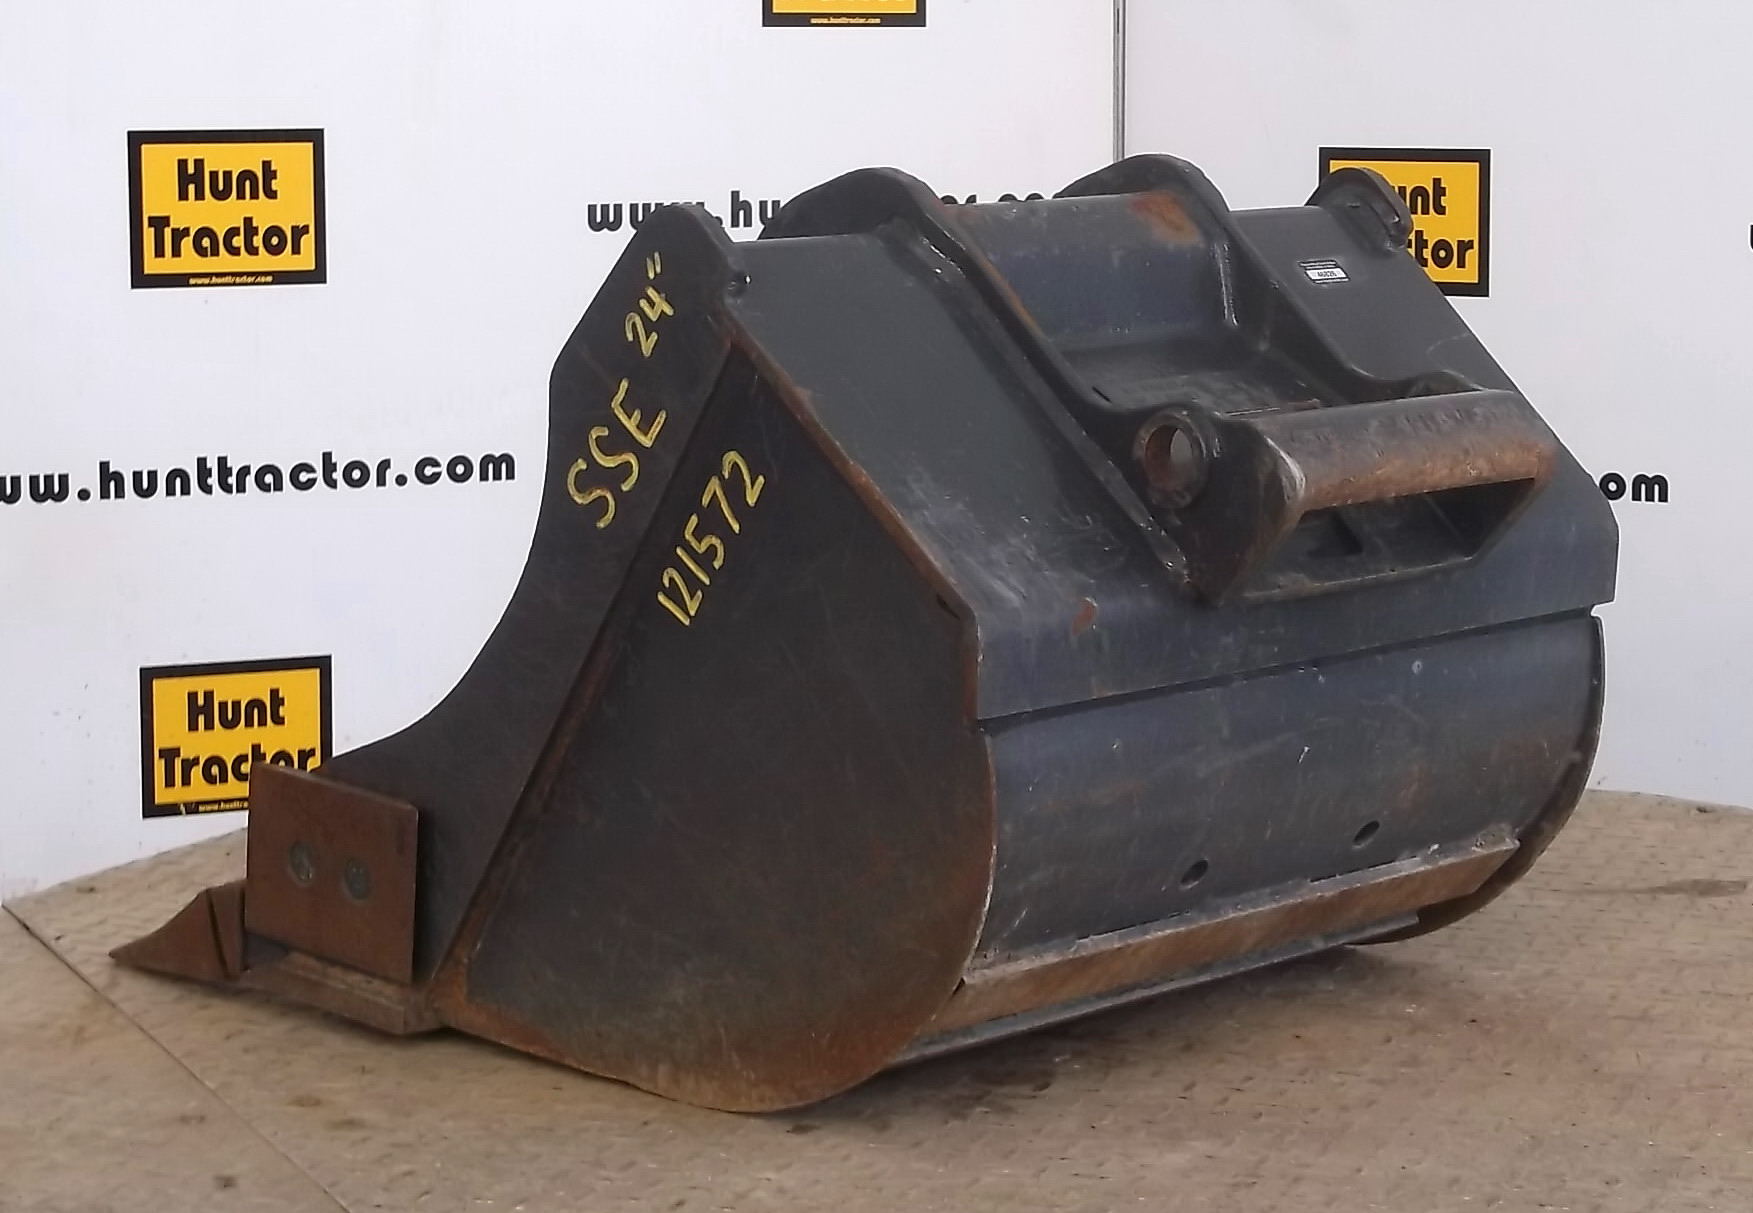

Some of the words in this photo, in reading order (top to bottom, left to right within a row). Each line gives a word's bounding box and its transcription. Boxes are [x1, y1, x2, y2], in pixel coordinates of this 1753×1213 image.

[177, 158, 278, 201] Hunt
[1392, 177, 1447, 215] nt
[147, 215, 310, 258] Tractor
[1406, 229, 1474, 269] tor
[567, 378, 667, 528] SSE
[657, 450, 765, 627] 121572
[187, 688, 286, 732] Hunt
